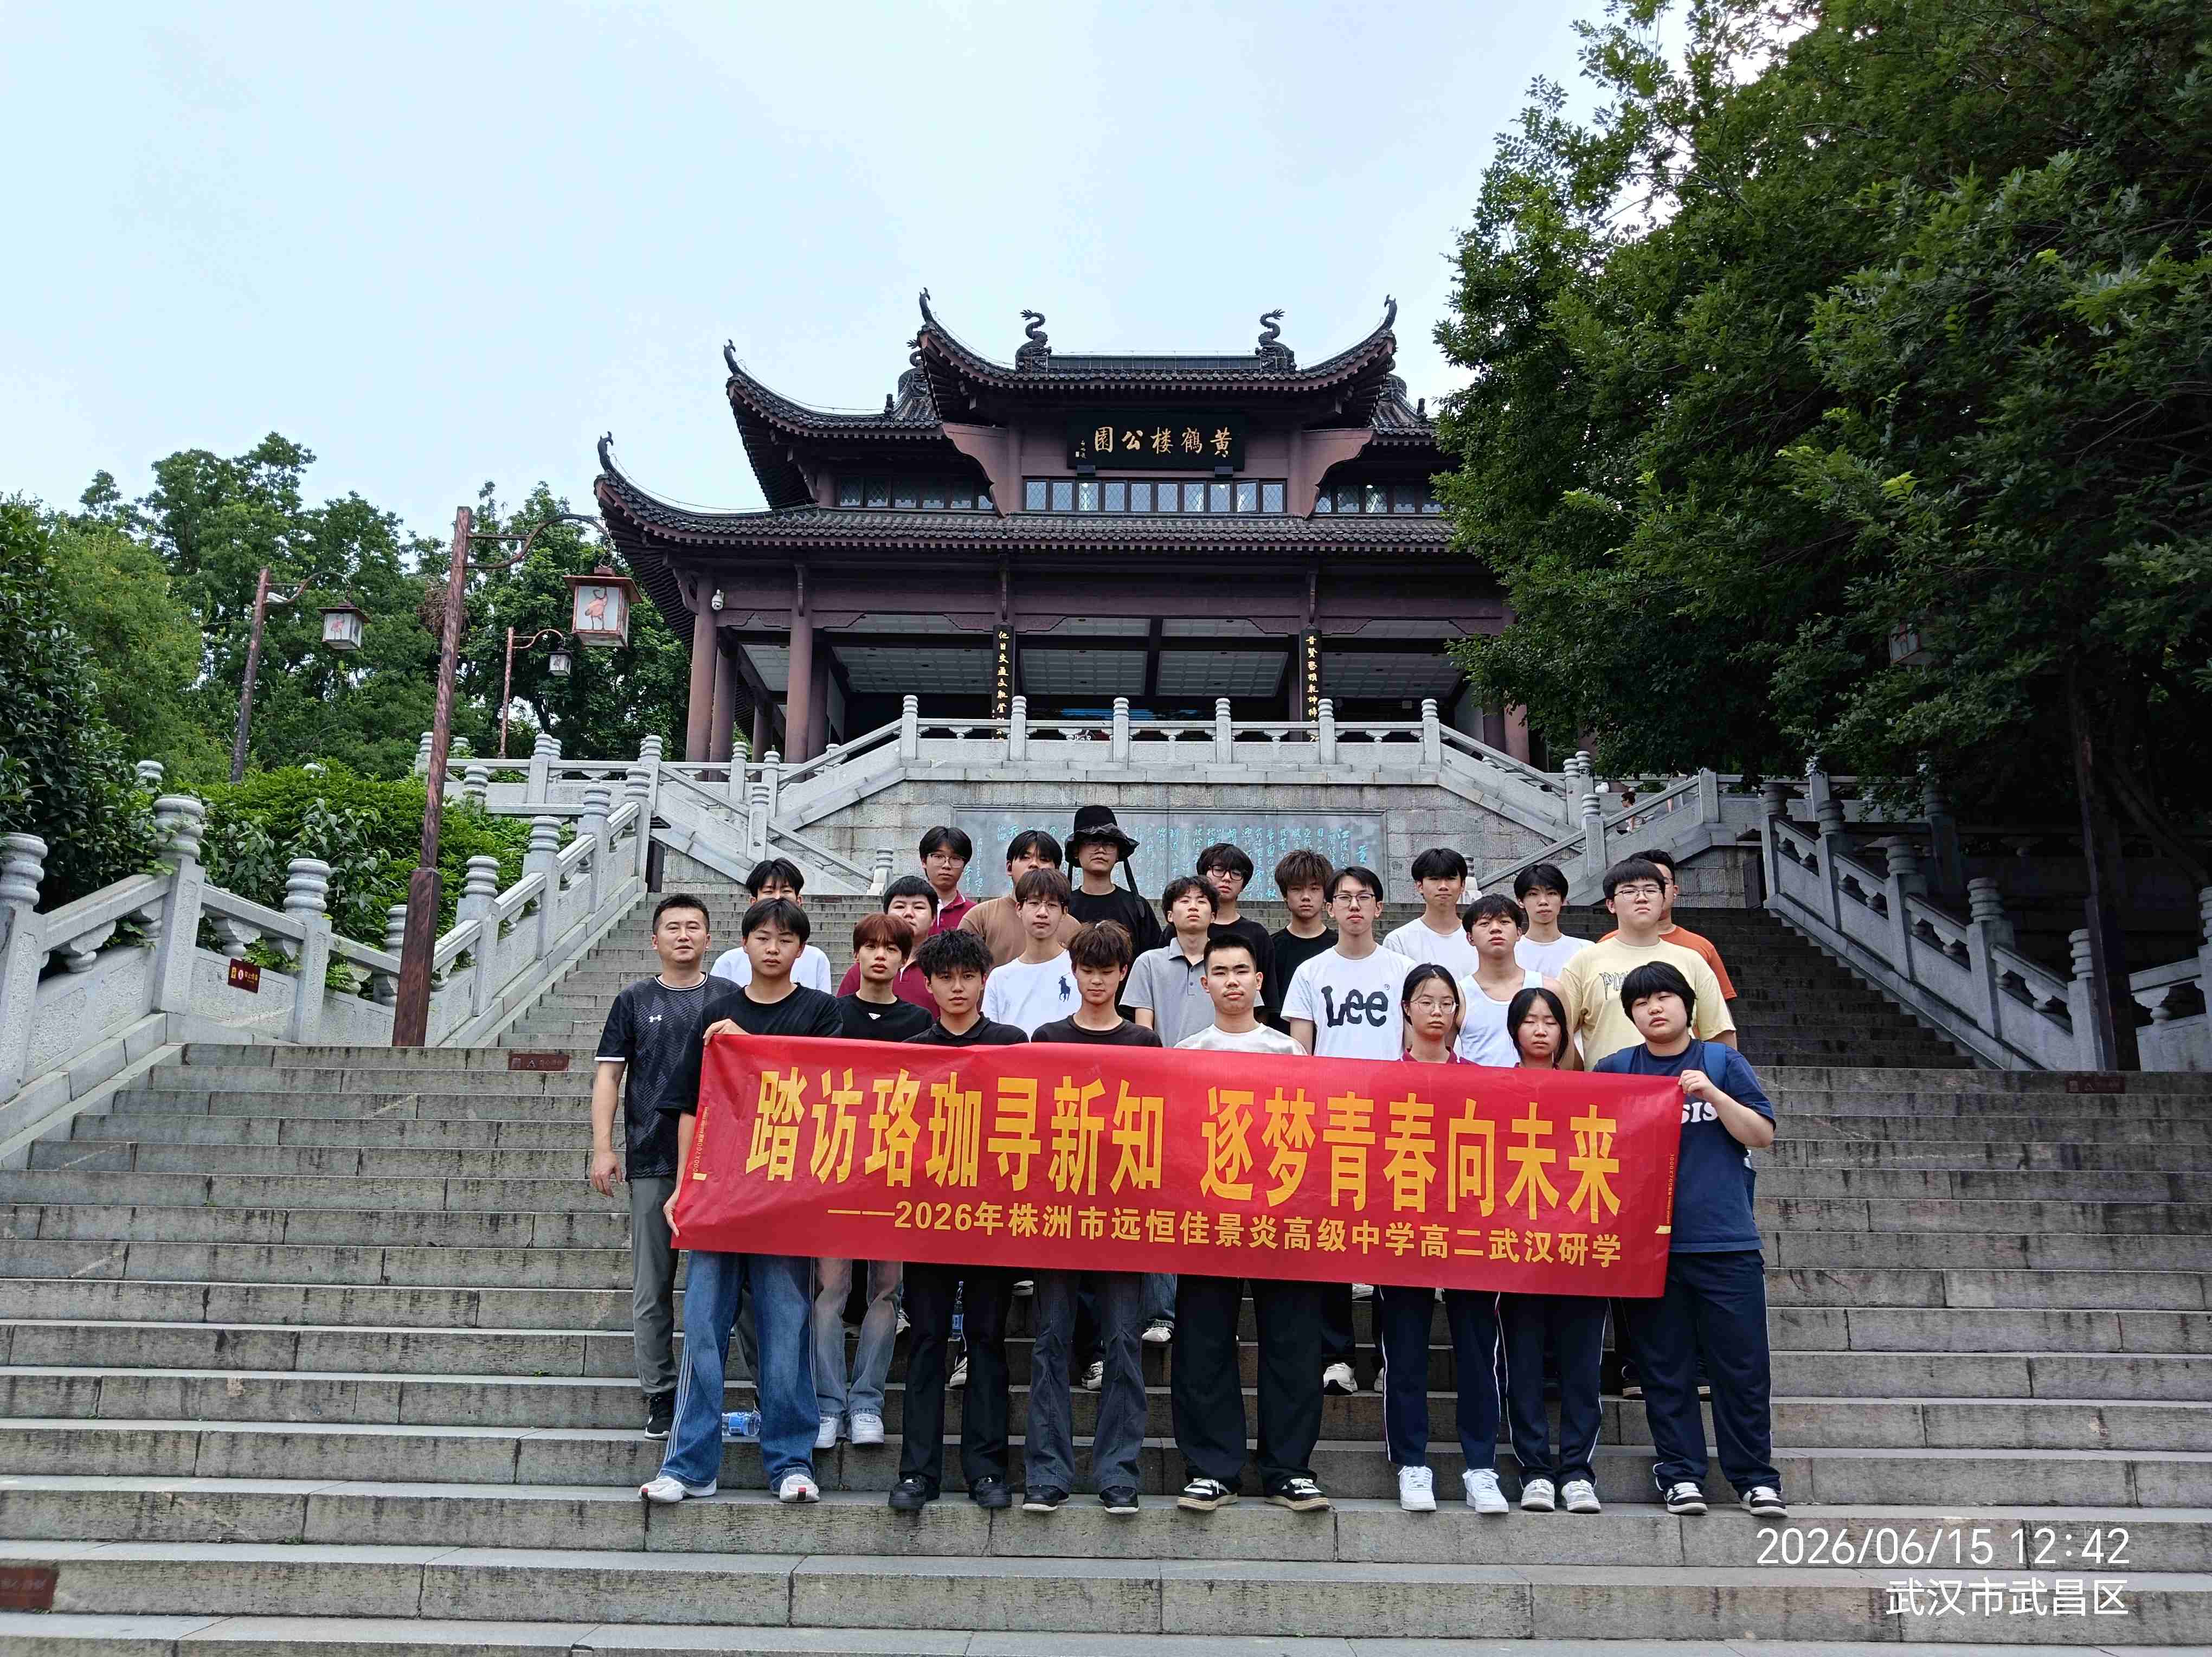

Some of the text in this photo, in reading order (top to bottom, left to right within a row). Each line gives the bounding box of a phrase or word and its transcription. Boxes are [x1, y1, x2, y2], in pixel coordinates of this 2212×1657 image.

[1321, 985, 1388, 1027] Lee
[745, 1066, 1622, 1224] 踏访珞珈寻新知 逐梦青春向未来
